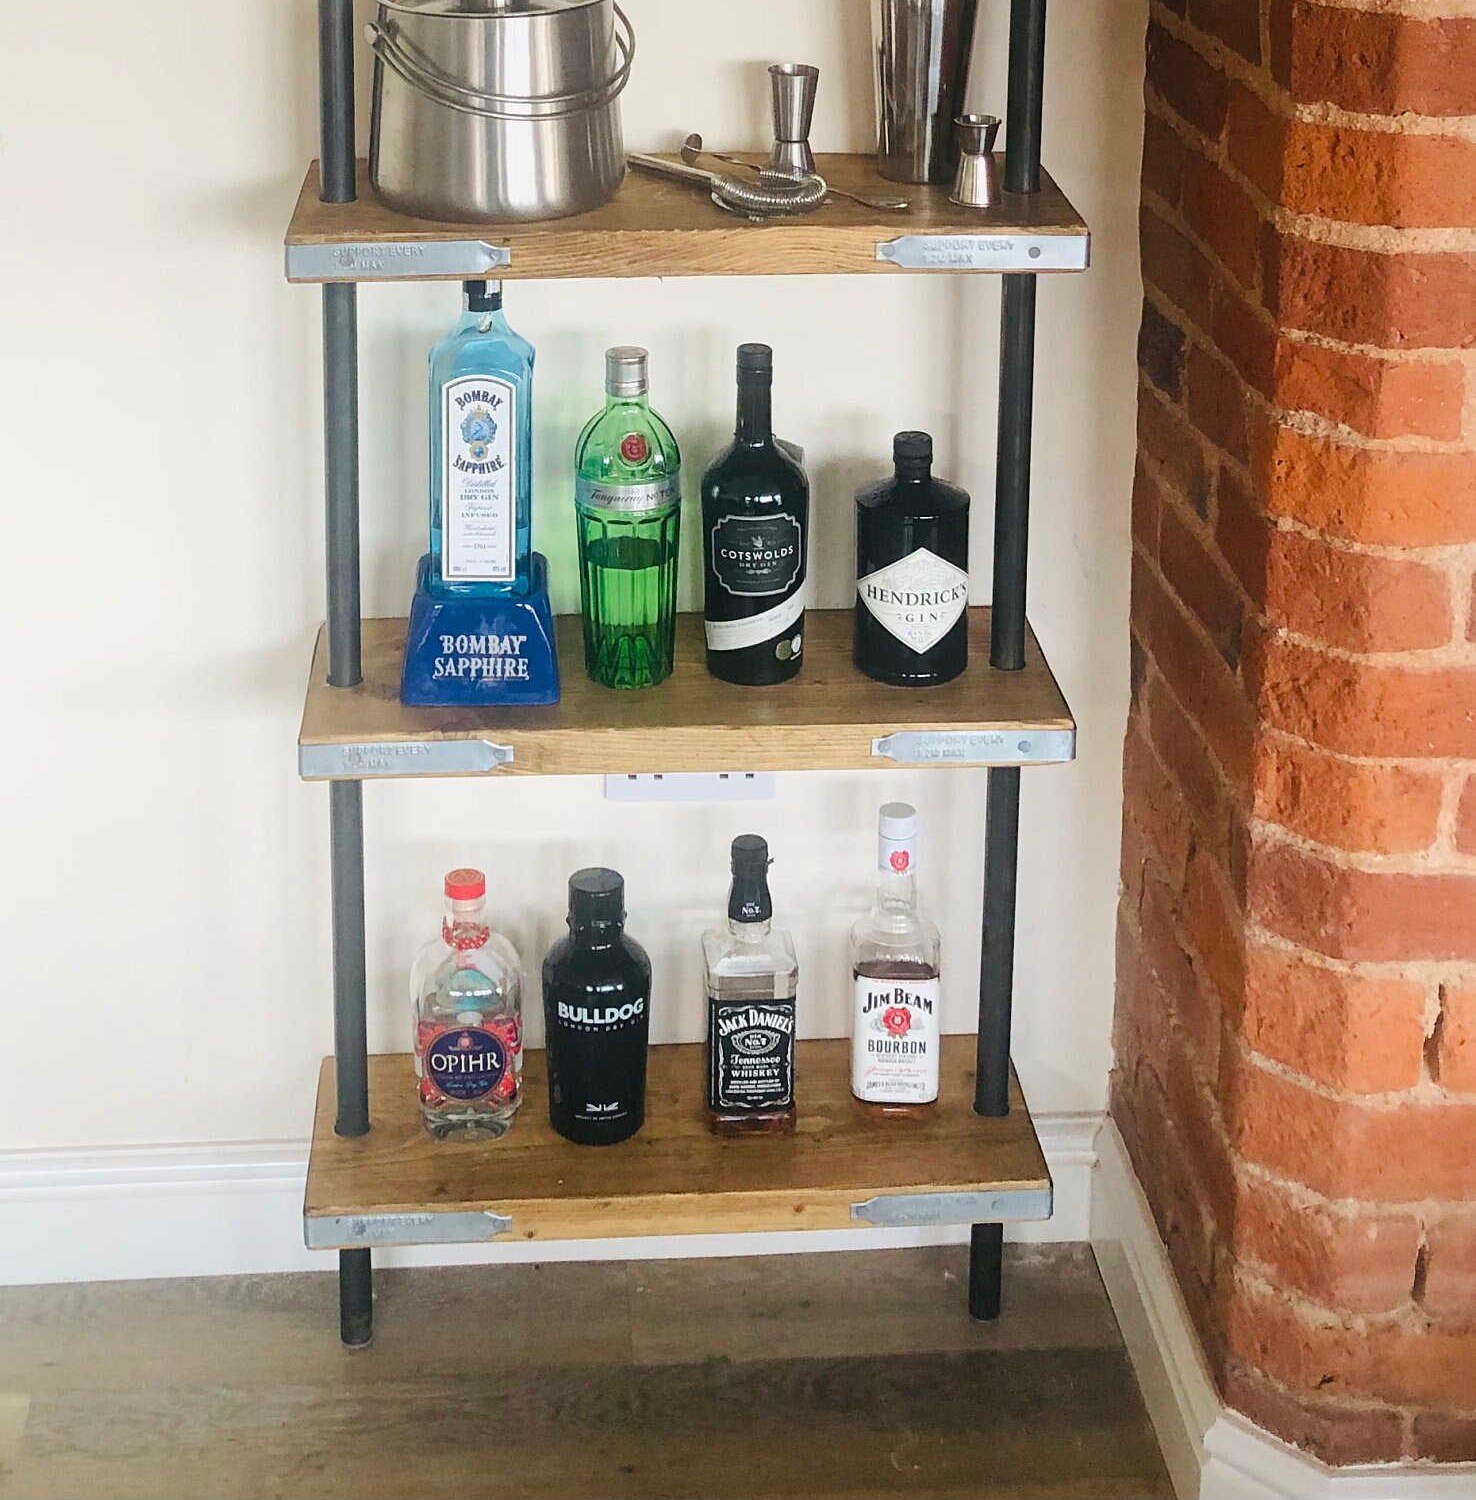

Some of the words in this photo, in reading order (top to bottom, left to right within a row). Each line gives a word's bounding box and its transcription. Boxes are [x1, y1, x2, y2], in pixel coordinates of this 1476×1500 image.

[388, 244, 426, 257] EVERY
[977, 239, 1015, 251] EVERY
[454, 390, 504, 411] BOMBAY
[452, 454, 505, 475] SAPPHIRE
[590, 488, 645, 505] Tanqueray
[720, 545, 794, 561] COTSWOLDS
[866, 581, 968, 607] HENDRICK'S
[905, 612, 938, 623] GIN
[439, 635, 527, 655] BOMBAY
[432, 657, 530, 681] SAPPHIRE
[862, 992, 891, 1014] JIM
[894, 987, 933, 1015] BEAM
[558, 997, 644, 1024] BULLDOG
[558, 1020, 599, 1032] LONDON
[605, 1023, 624, 1032] DRY
[718, 1013, 748, 1037] JACK
[748, 1008, 794, 1035] DANIEL'S
[867, 1039, 927, 1055] BOURBON
[431, 1051, 501, 1073] OPIHR
[730, 1054, 781, 1065] Tennessee
[731, 1068, 780, 1078] WHISKEY
